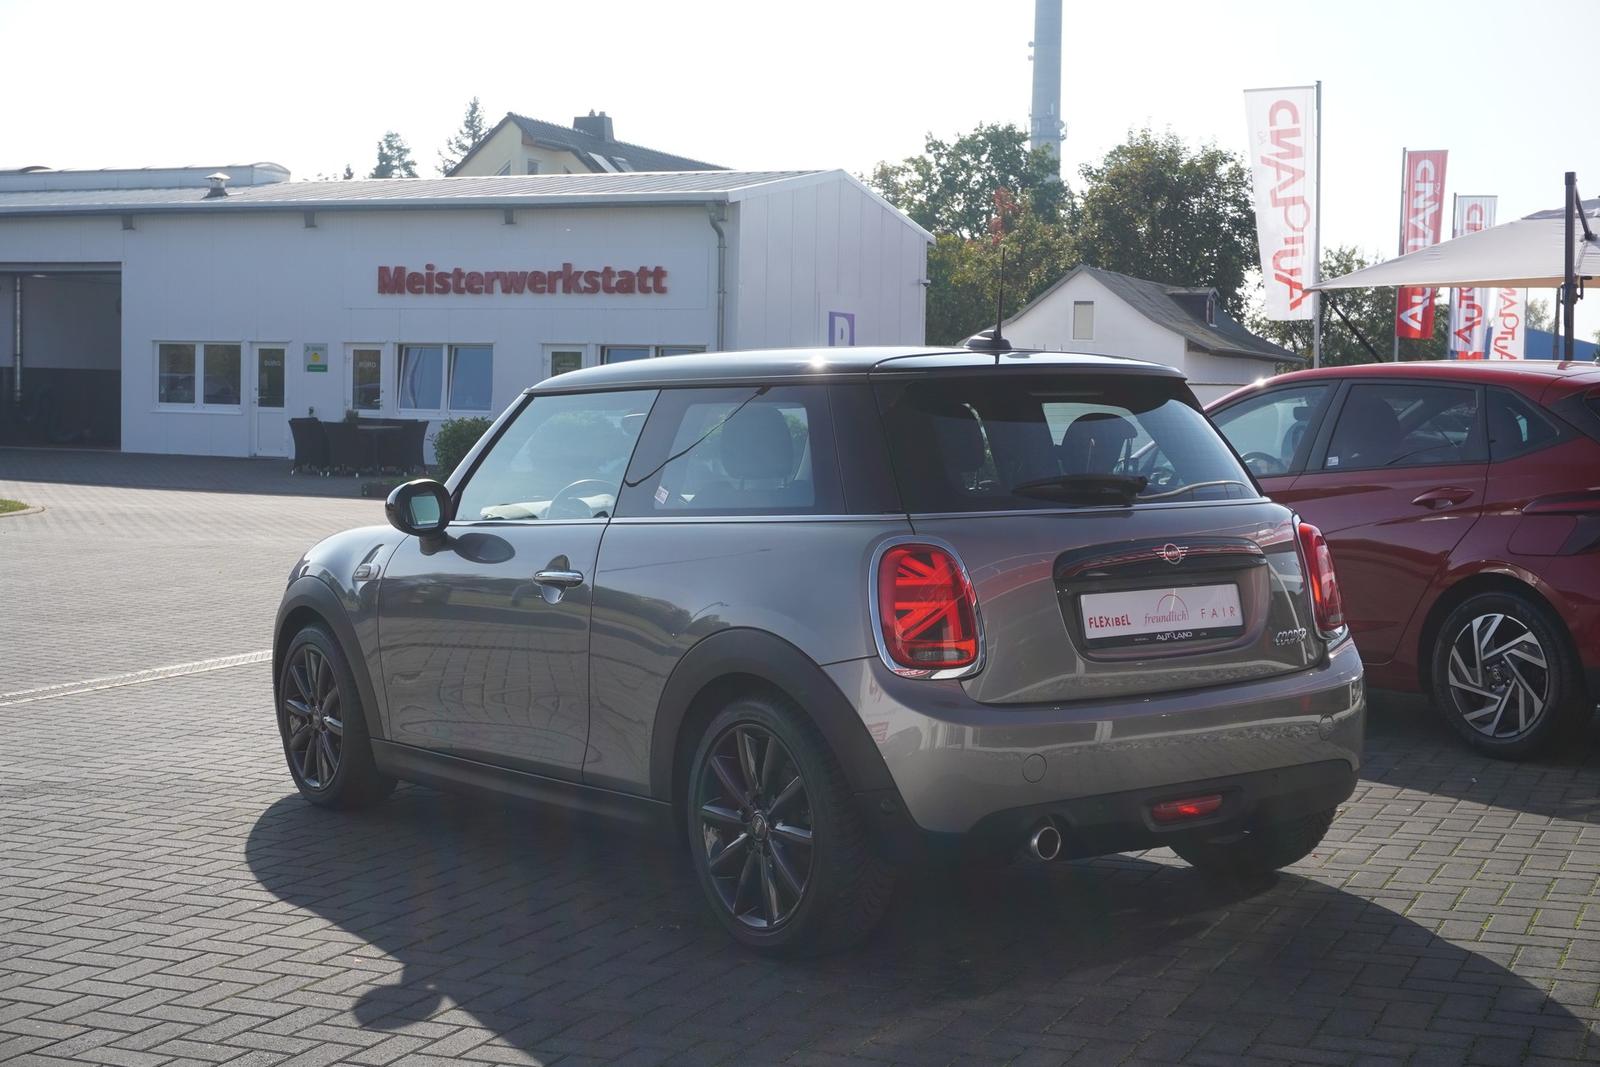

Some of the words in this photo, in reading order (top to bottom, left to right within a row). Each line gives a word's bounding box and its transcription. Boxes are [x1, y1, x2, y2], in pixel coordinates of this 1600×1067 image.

[377, 262, 668, 295] Meisterwerkstatt
[1088, 613, 1132, 629] FLEXIBEL
[1144, 610, 1187, 627] freundlich
